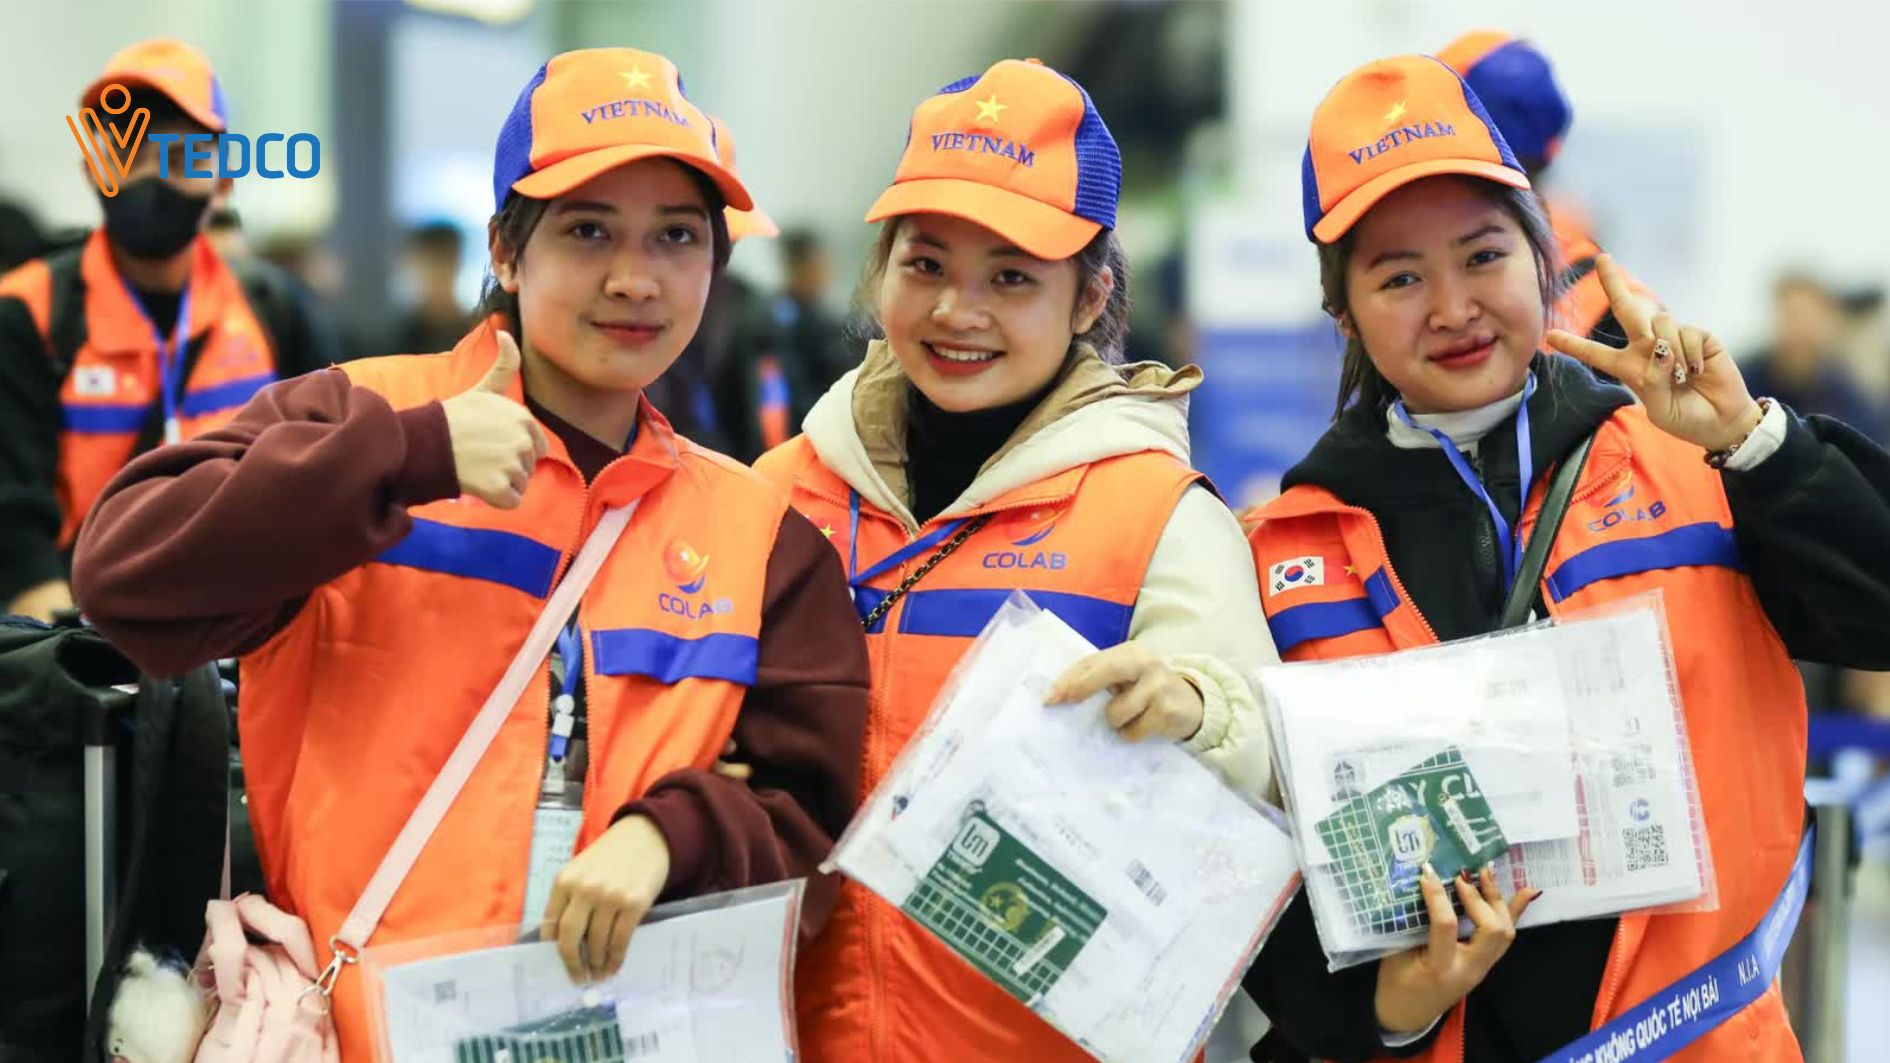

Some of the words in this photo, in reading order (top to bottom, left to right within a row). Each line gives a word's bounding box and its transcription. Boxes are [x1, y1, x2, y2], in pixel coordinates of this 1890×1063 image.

[581, 99, 690, 127] VIETNAM
[931, 131, 1035, 169] VIETNAM
[1348, 120, 1456, 165] VIETNAM
[1589, 500, 1666, 532] COLAB
[982, 551, 1068, 570] COLAB
[658, 592, 733, 619] COLAB
